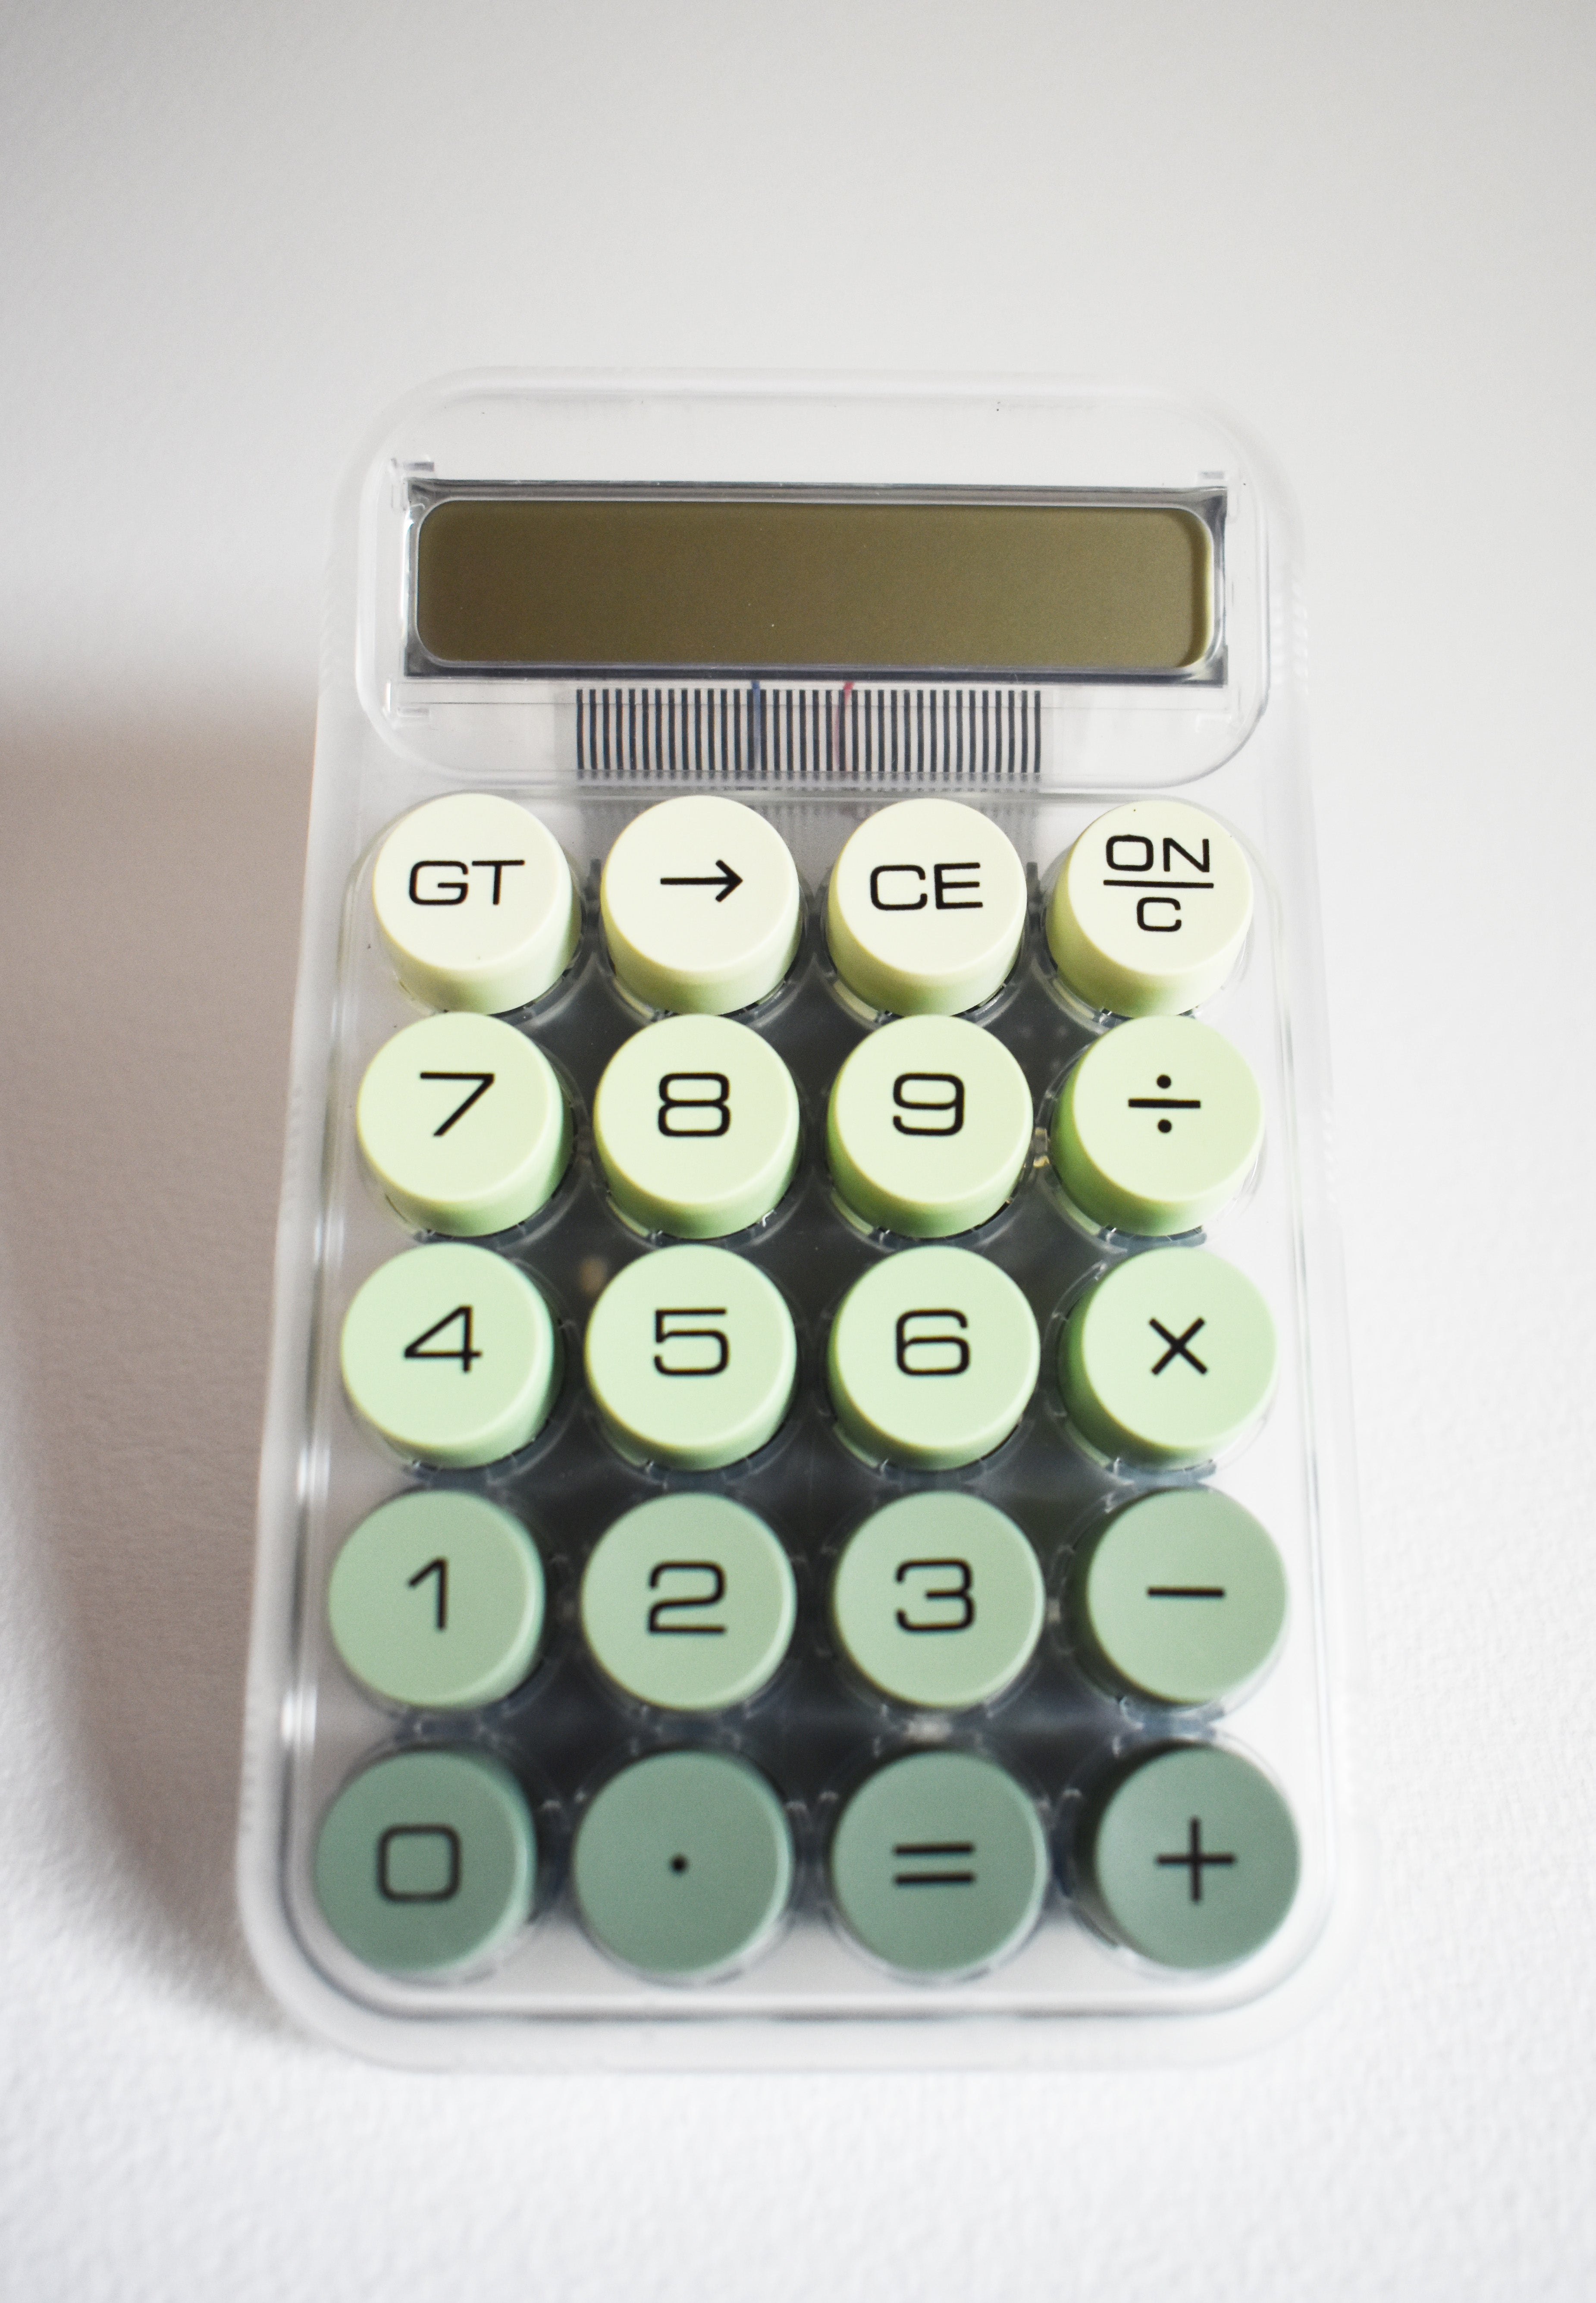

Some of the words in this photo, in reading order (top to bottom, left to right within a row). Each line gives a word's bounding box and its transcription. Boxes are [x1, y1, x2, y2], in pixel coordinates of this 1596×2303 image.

[409, 860, 525, 905] GT
[1106, 835, 1210, 872] ON
[870, 863, 983, 911] CE
[1137, 897, 1182, 932] C
[420, 1072, 494, 1136] 7
[658, 1073, 731, 1137] 8
[893, 1073, 964, 1136] 9
[404, 1306, 481, 1373] 4
[654, 1308, 729, 1377] 5
[896, 1309, 970, 1376] 6
[408, 1558, 447, 1631] 1
[647, 1562, 726, 1635] 2
[896, 1559, 975, 1634] 3
[376, 1824, 462, 1905] 0
